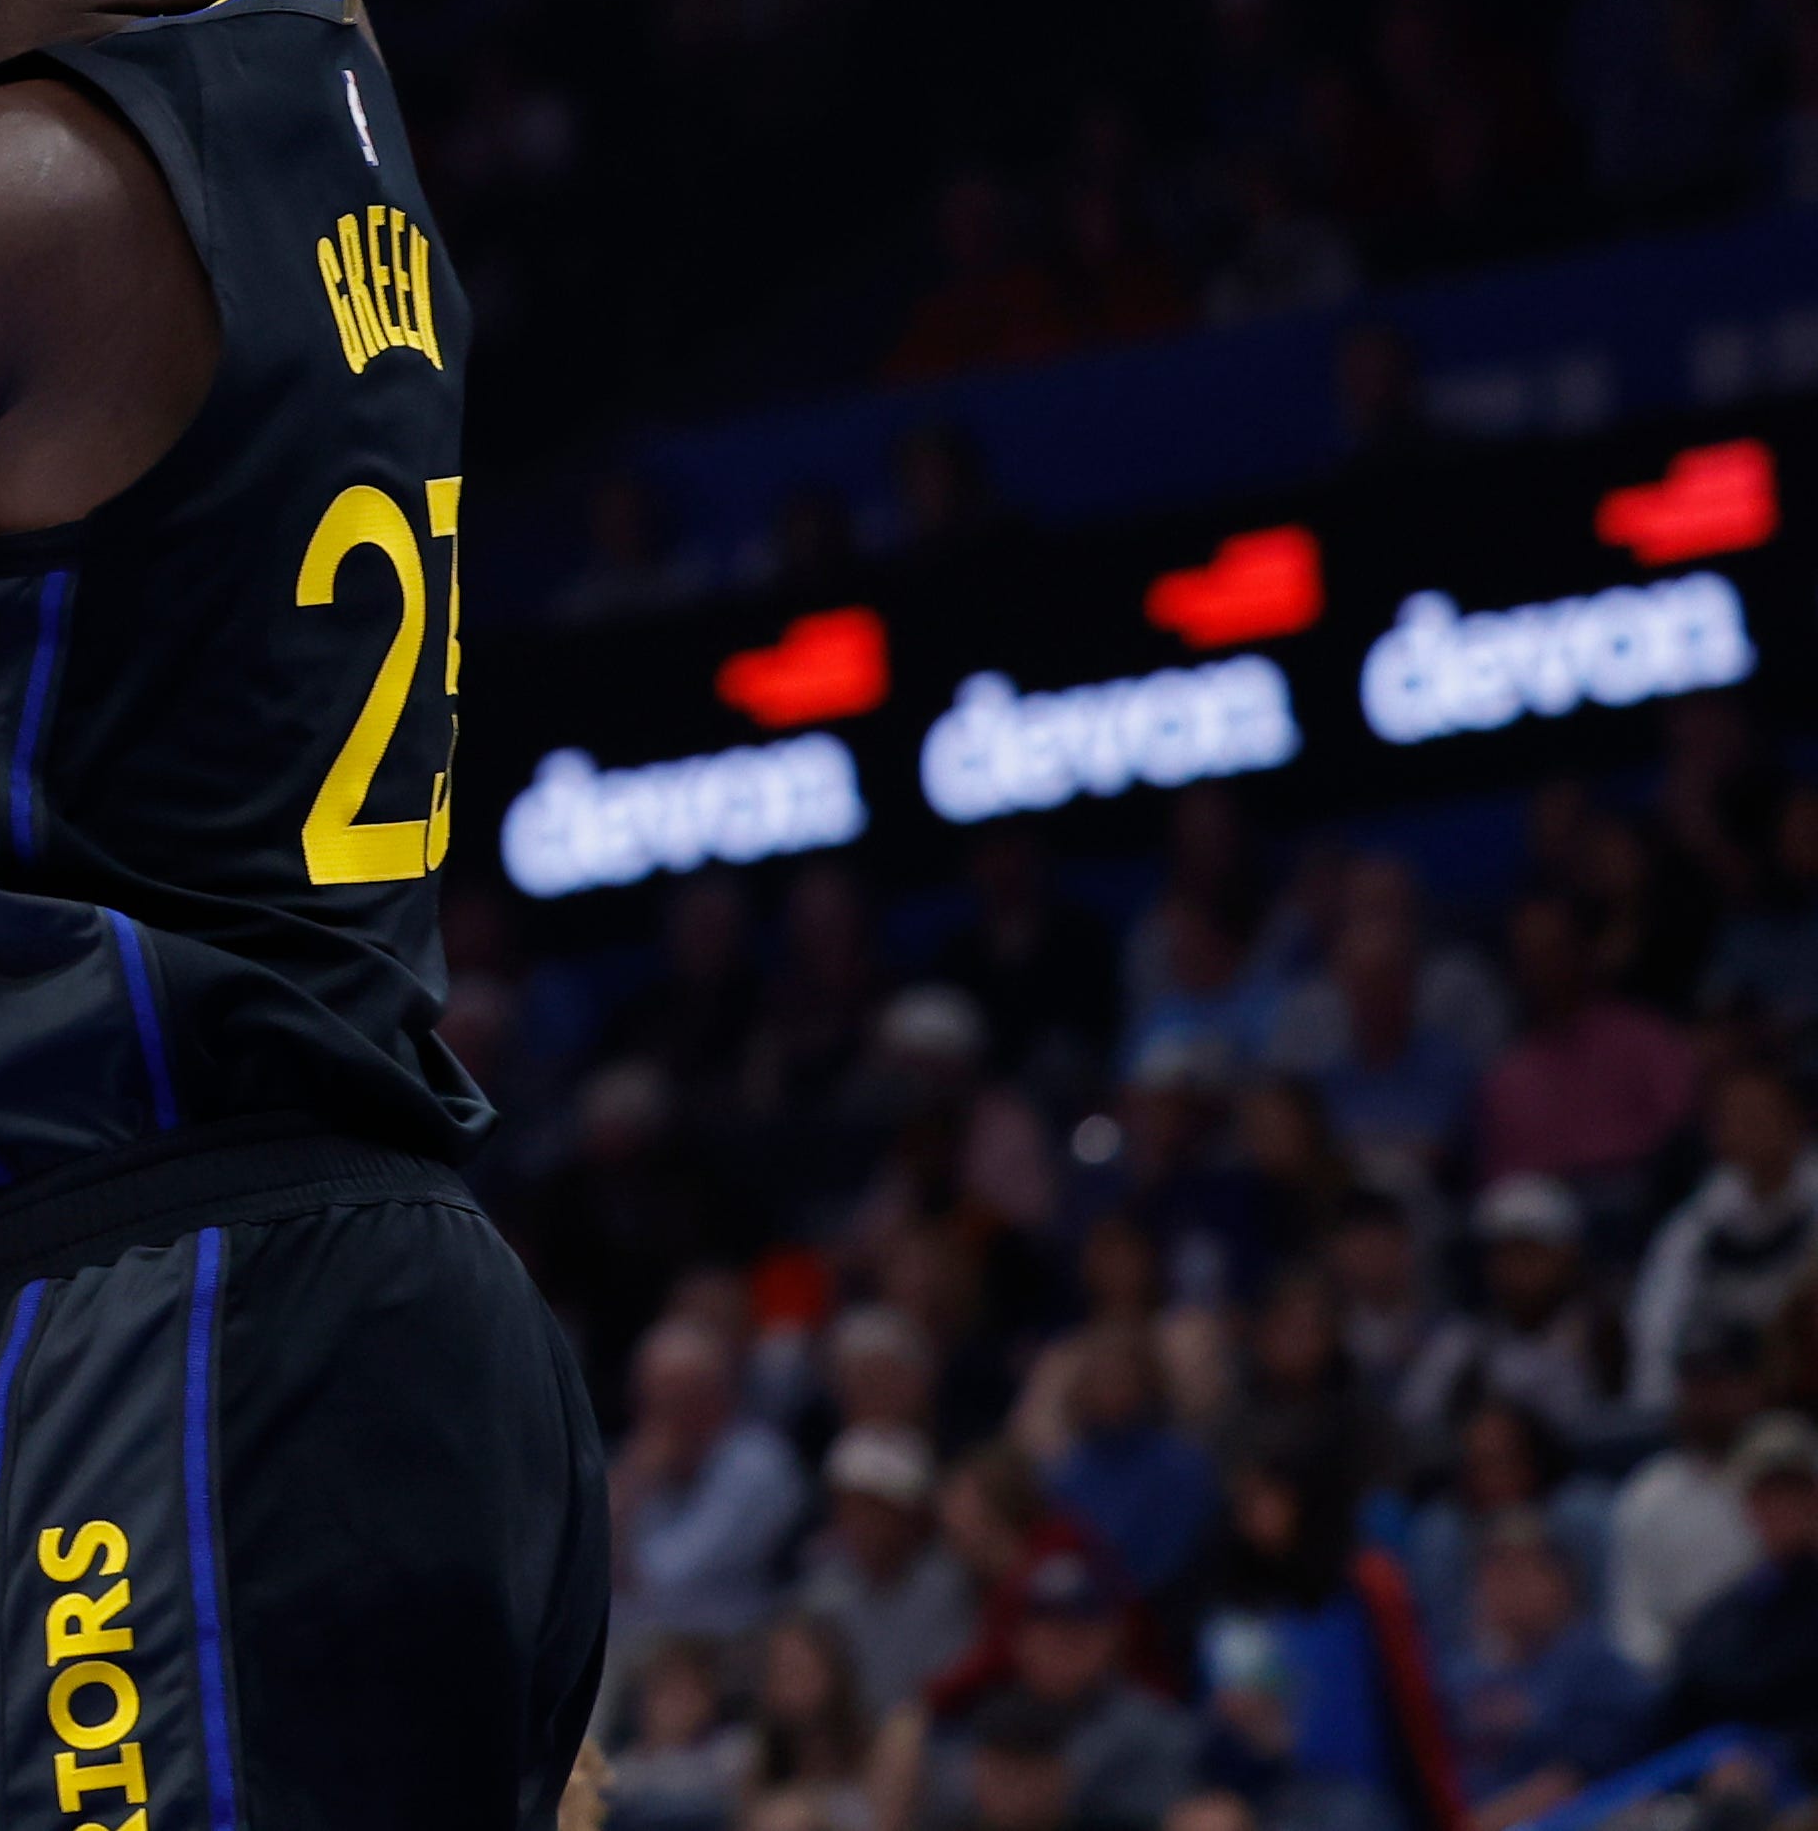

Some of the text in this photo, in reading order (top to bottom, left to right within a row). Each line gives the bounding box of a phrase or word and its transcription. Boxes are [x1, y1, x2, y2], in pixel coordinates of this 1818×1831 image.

[316, 205, 443, 374] GREEN
[922, 655, 1297, 821] devon
[1361, 573, 1753, 742] devon
[502, 734, 862, 897] devon
